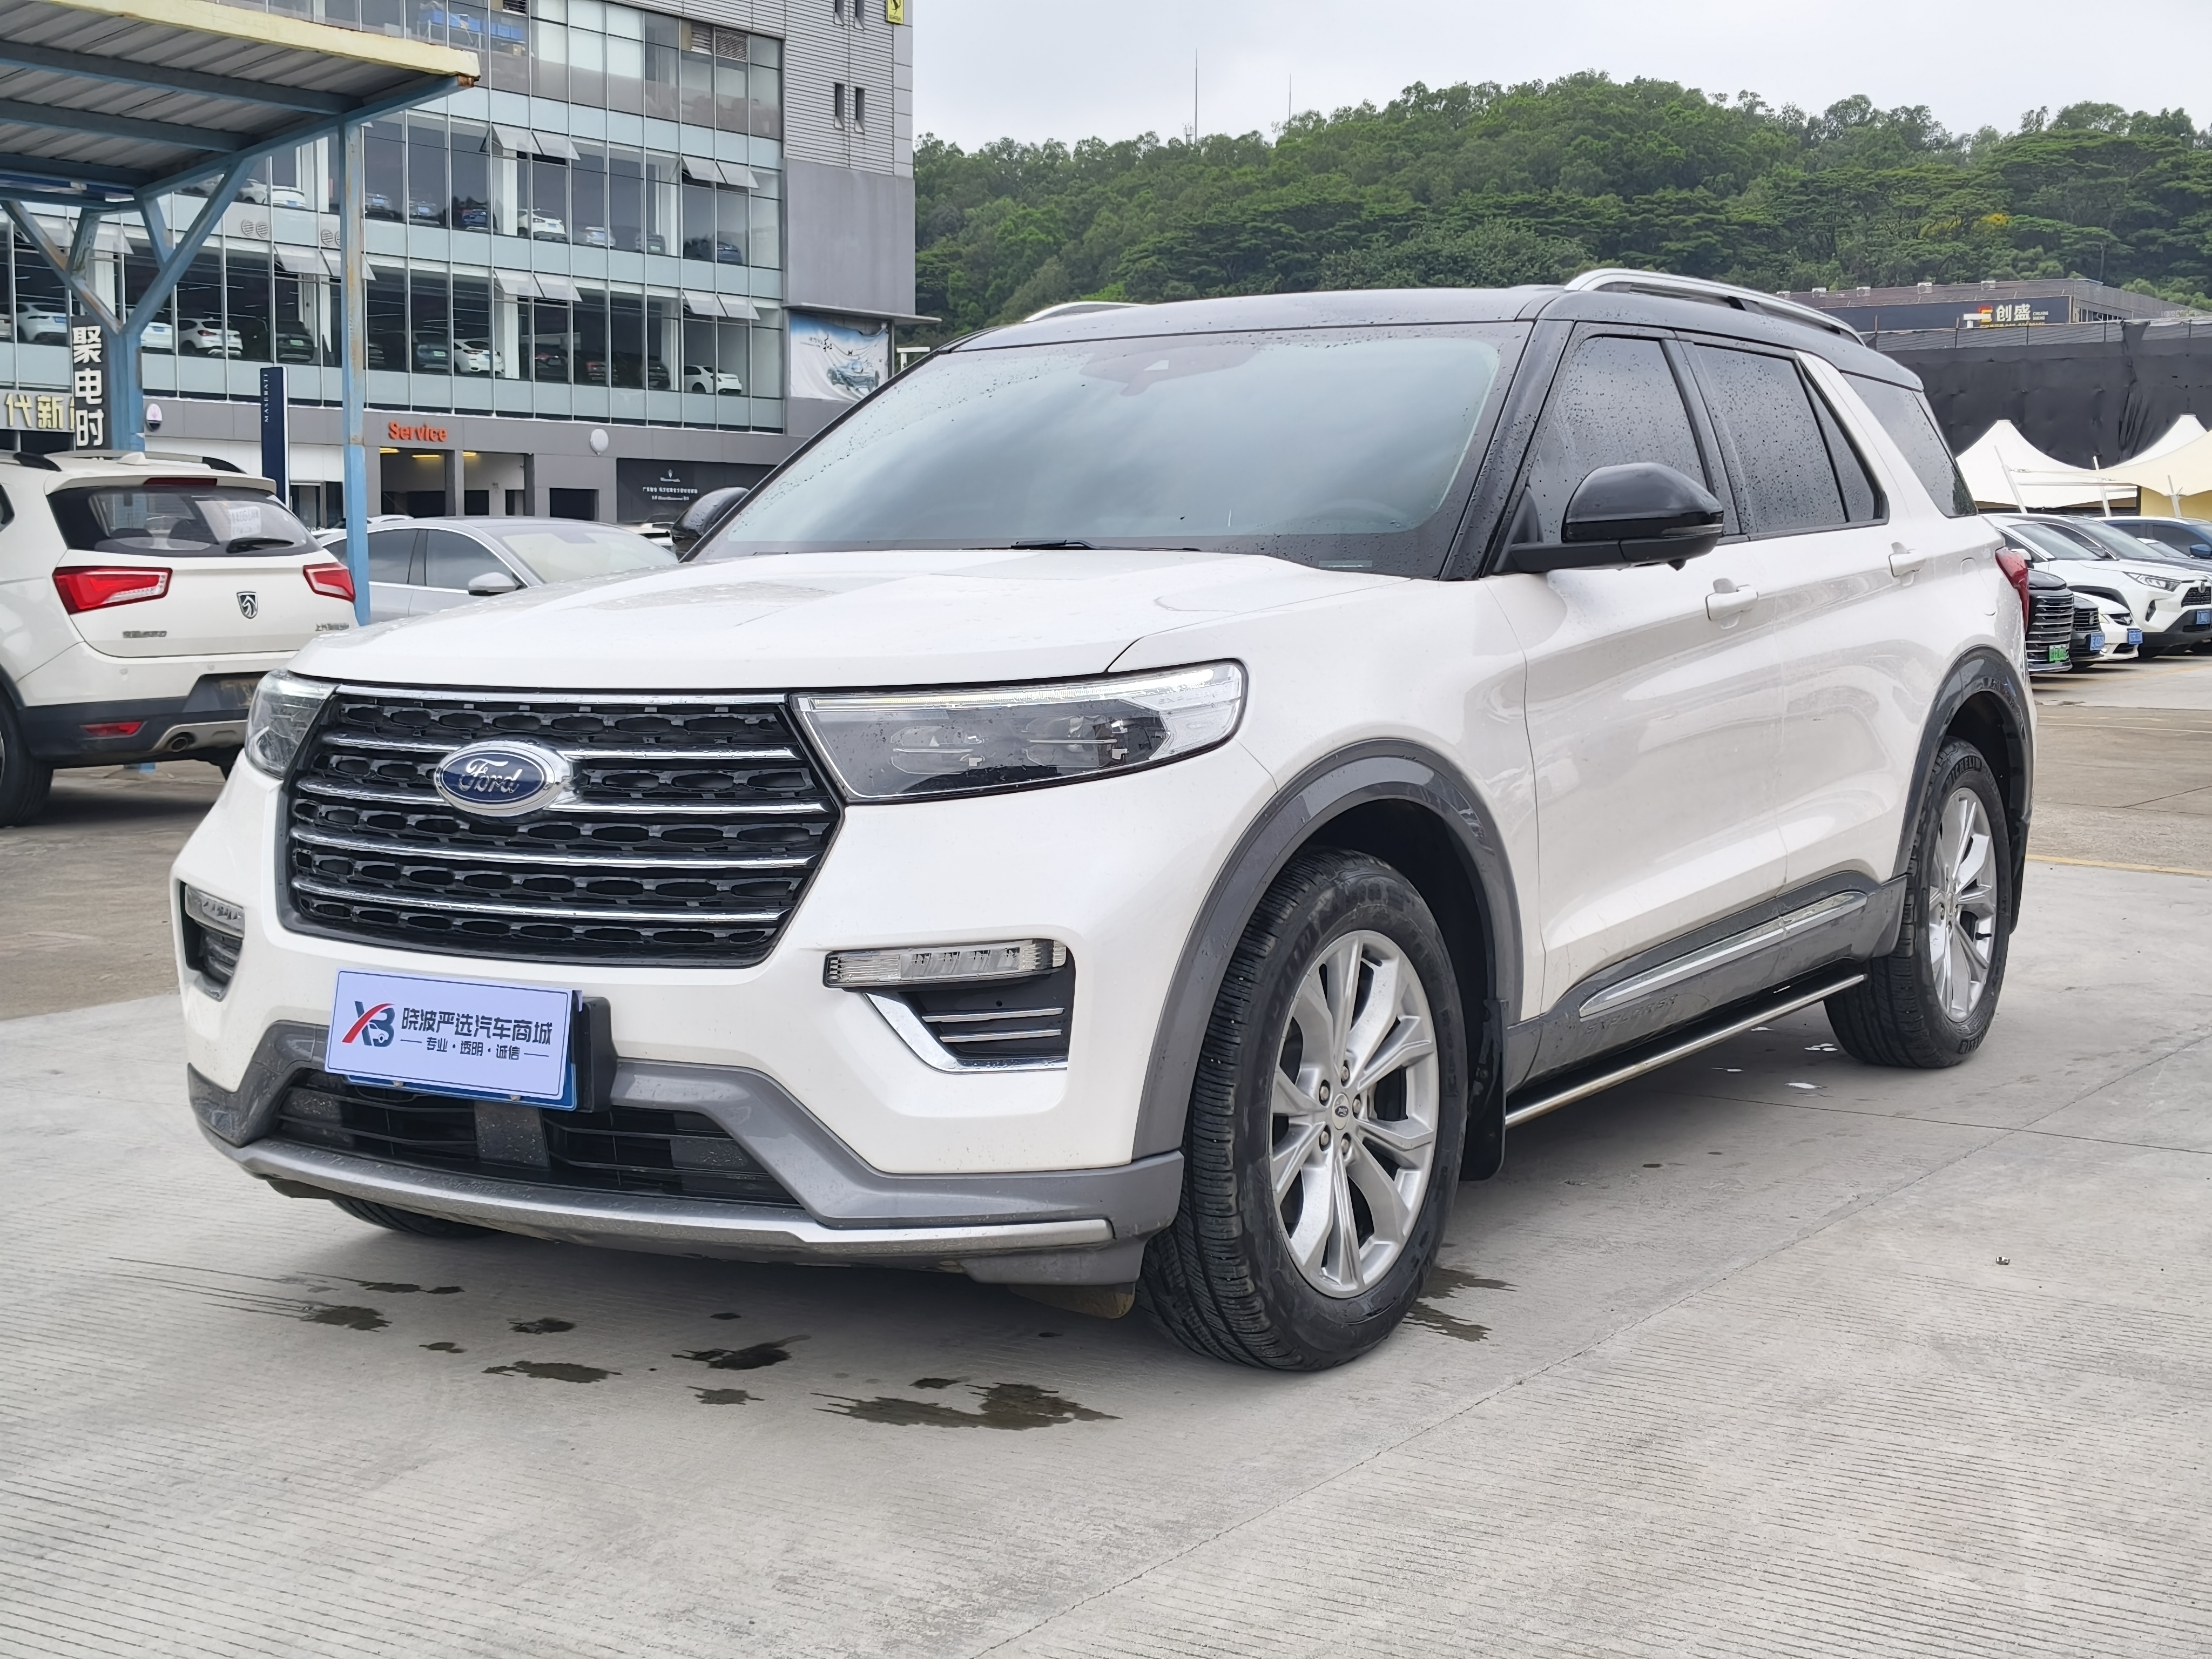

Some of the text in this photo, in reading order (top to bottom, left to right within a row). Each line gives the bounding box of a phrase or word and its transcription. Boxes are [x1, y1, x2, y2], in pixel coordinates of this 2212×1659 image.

[1996, 303, 2031, 322] 创盛
[72, 326, 104, 462] 聚电时
[388, 420, 448, 442] Service
[458, 758, 523, 793] Ford
[401, 1007, 553, 1045] 晓波严选汽车商城
